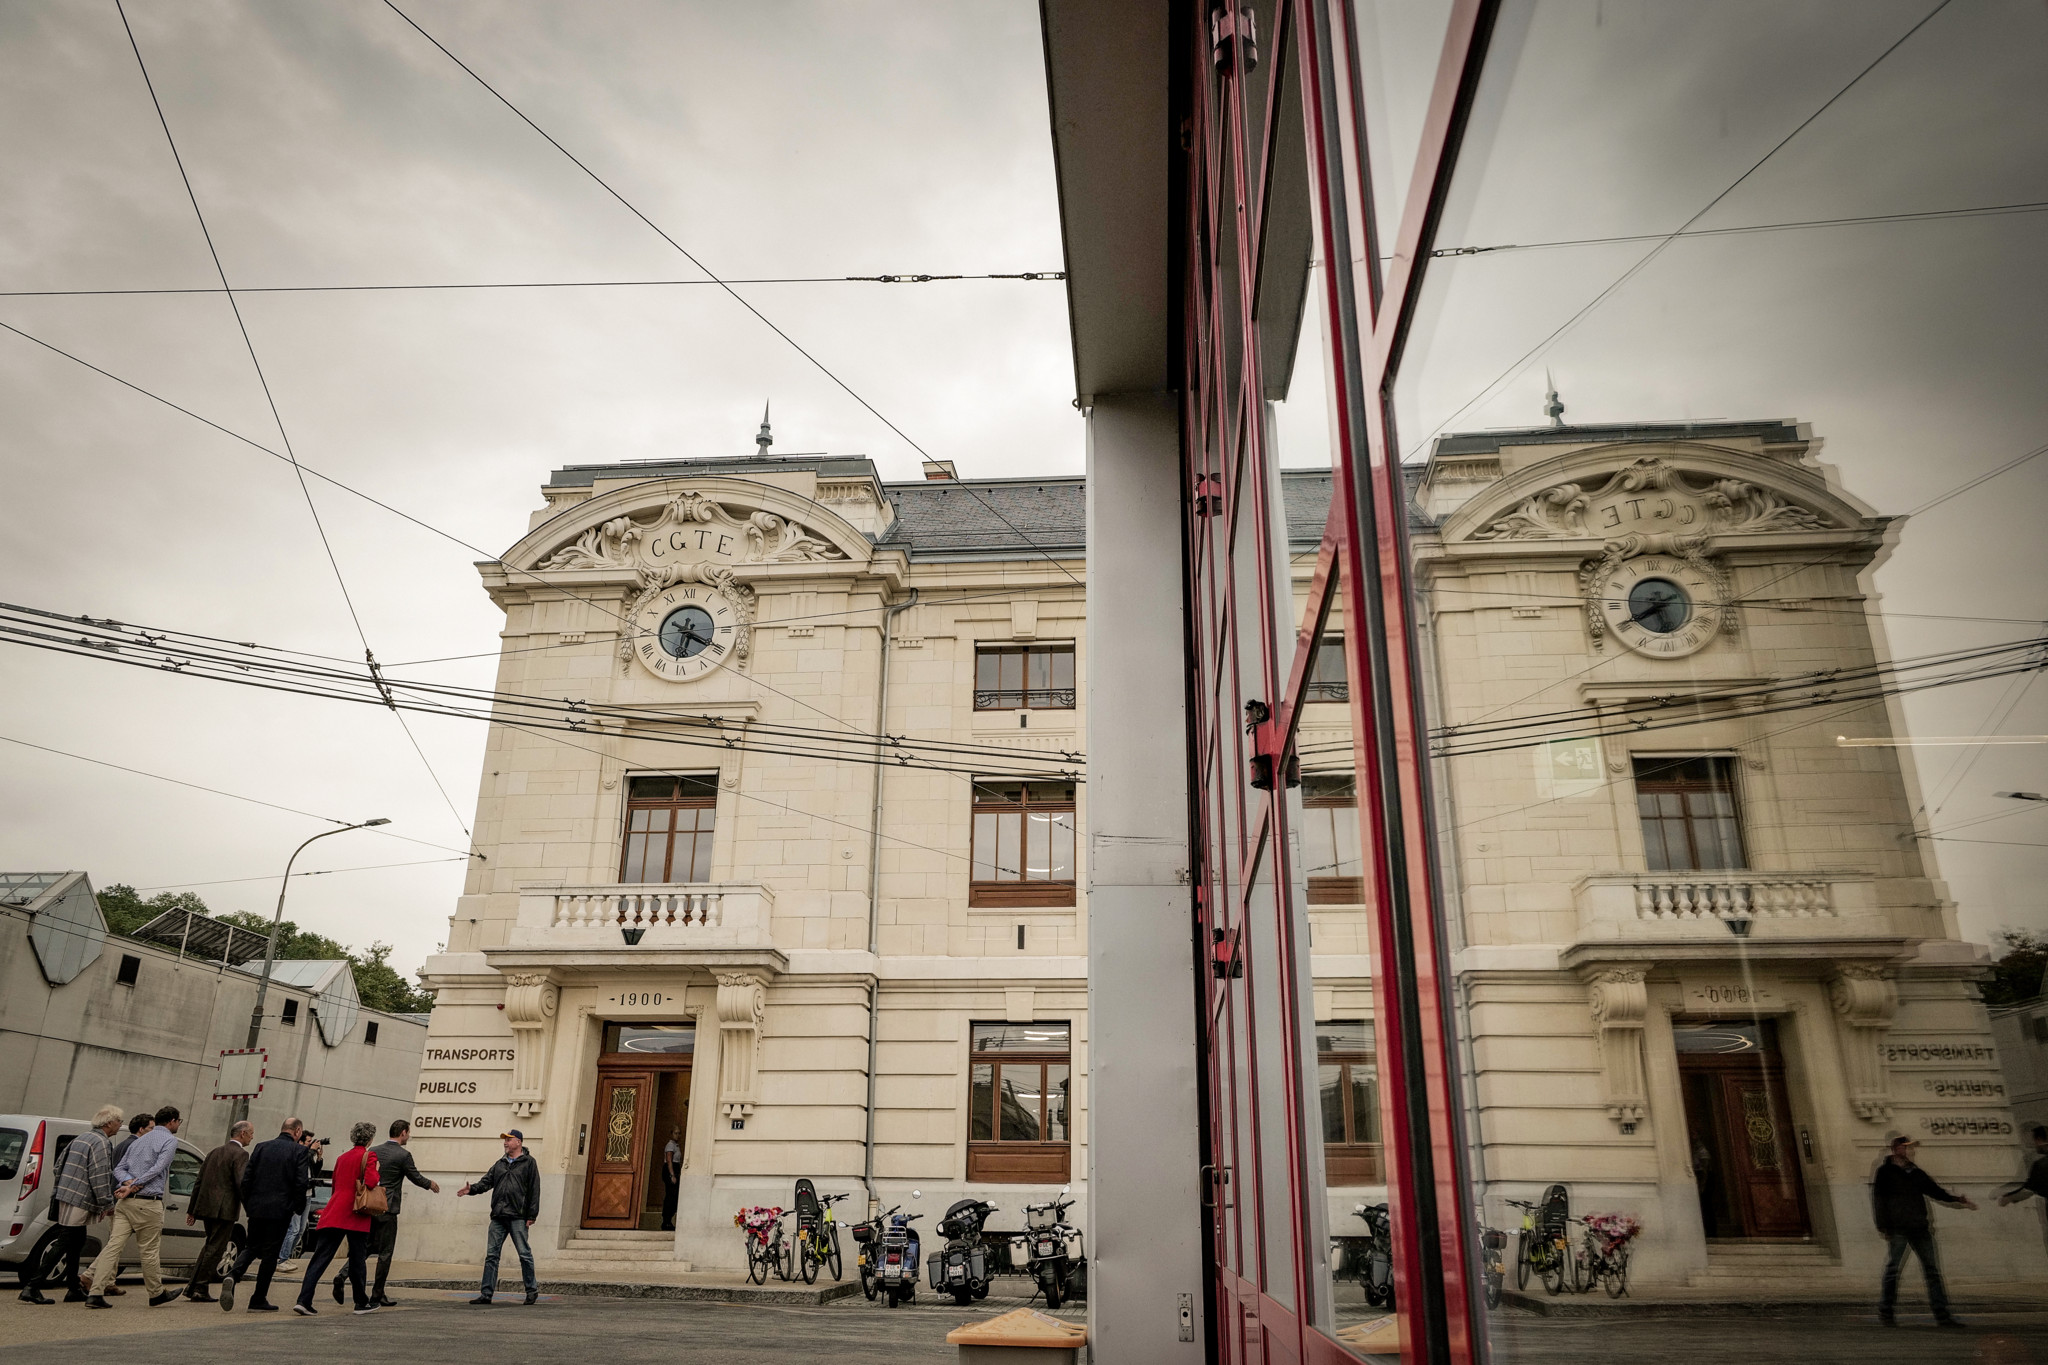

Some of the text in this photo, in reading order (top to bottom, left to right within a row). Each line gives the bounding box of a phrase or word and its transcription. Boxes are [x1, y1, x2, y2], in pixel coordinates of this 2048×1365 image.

[651, 529, 734, 557] CGTE
[663, 593, 676, 606] XI
[683, 588, 696, 600] XII
[705, 593, 713, 603] I
[647, 608, 659, 619] X
[716, 607, 728, 616] II
[426, 1048, 515, 1061] TRANSPORTS
[419, 1081, 477, 1094] PUBLICS
[414, 1116, 482, 1129] GENEVOIS
[733, 1120, 743, 1130] 17
